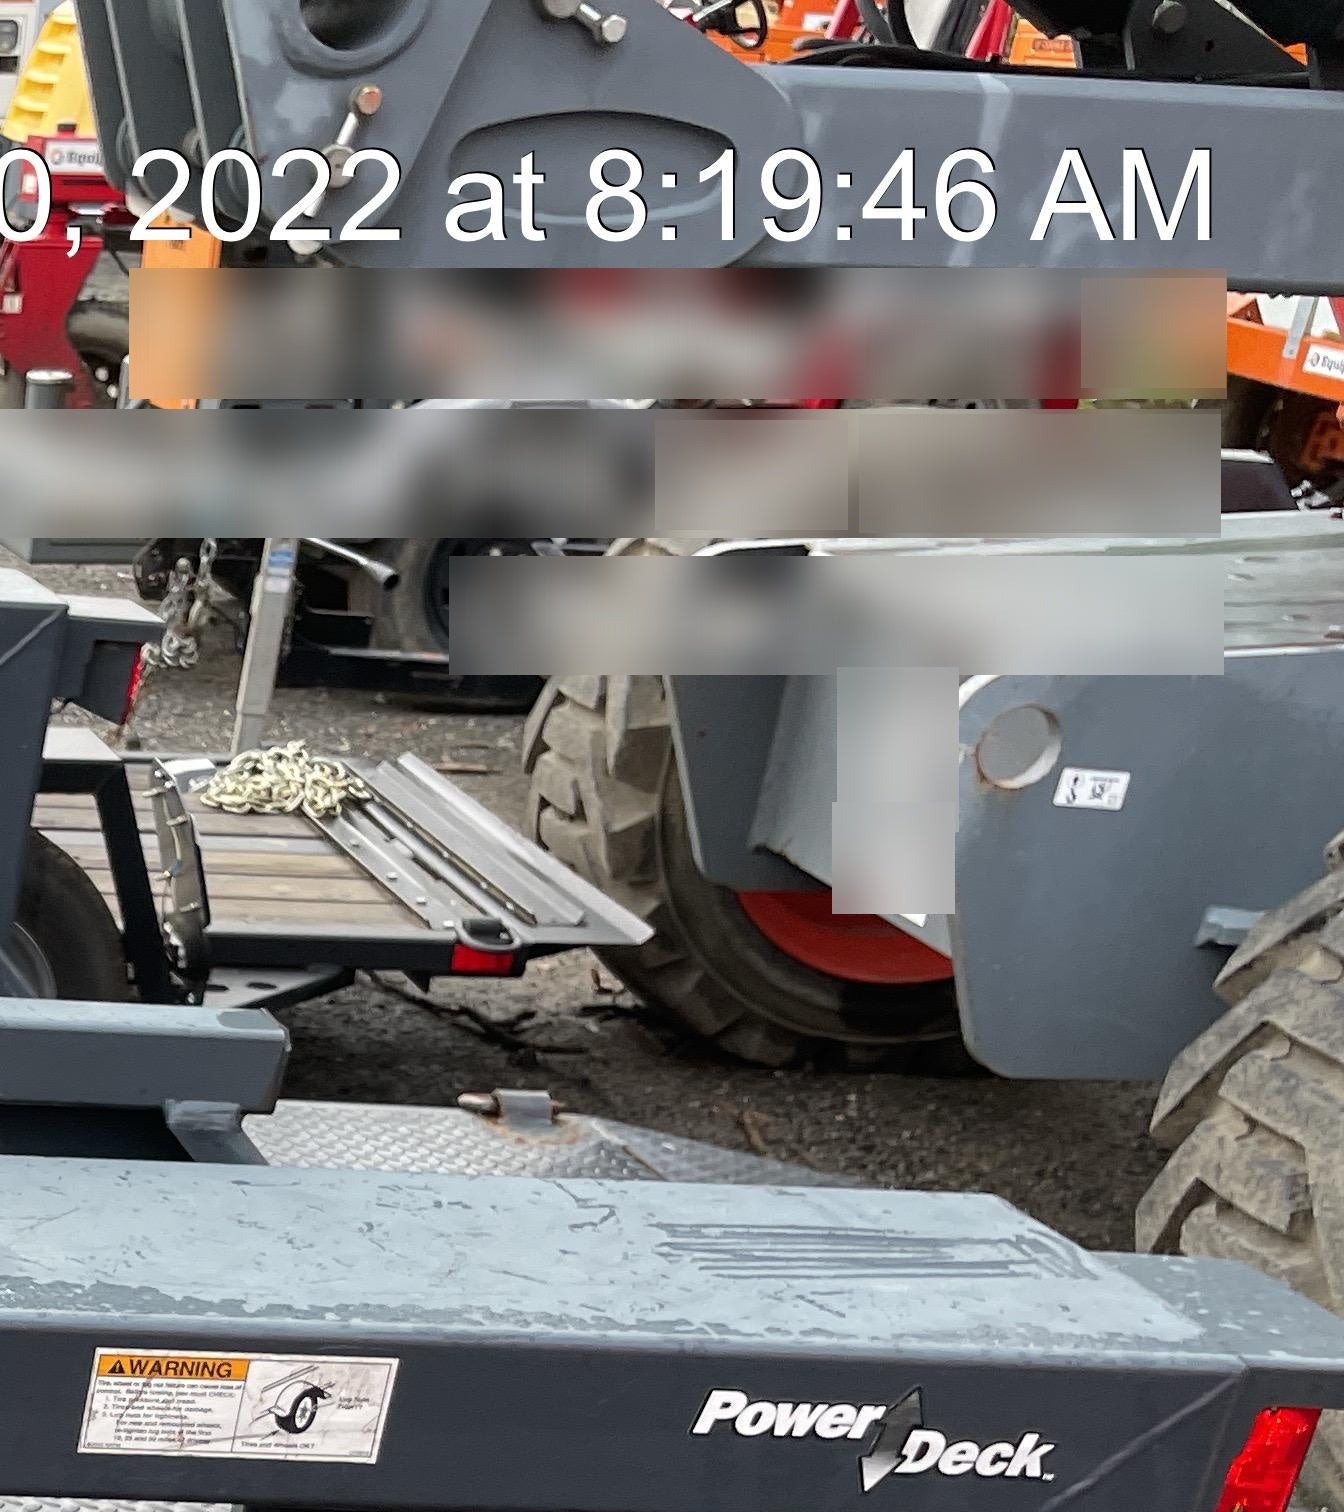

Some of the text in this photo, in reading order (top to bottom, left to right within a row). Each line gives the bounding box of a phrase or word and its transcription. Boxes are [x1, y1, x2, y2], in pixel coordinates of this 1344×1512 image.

[129, 1359, 232, 1378] WARNING
[691, 1390, 886, 1440] Power
[896, 1429, 1054, 1478] Deck
